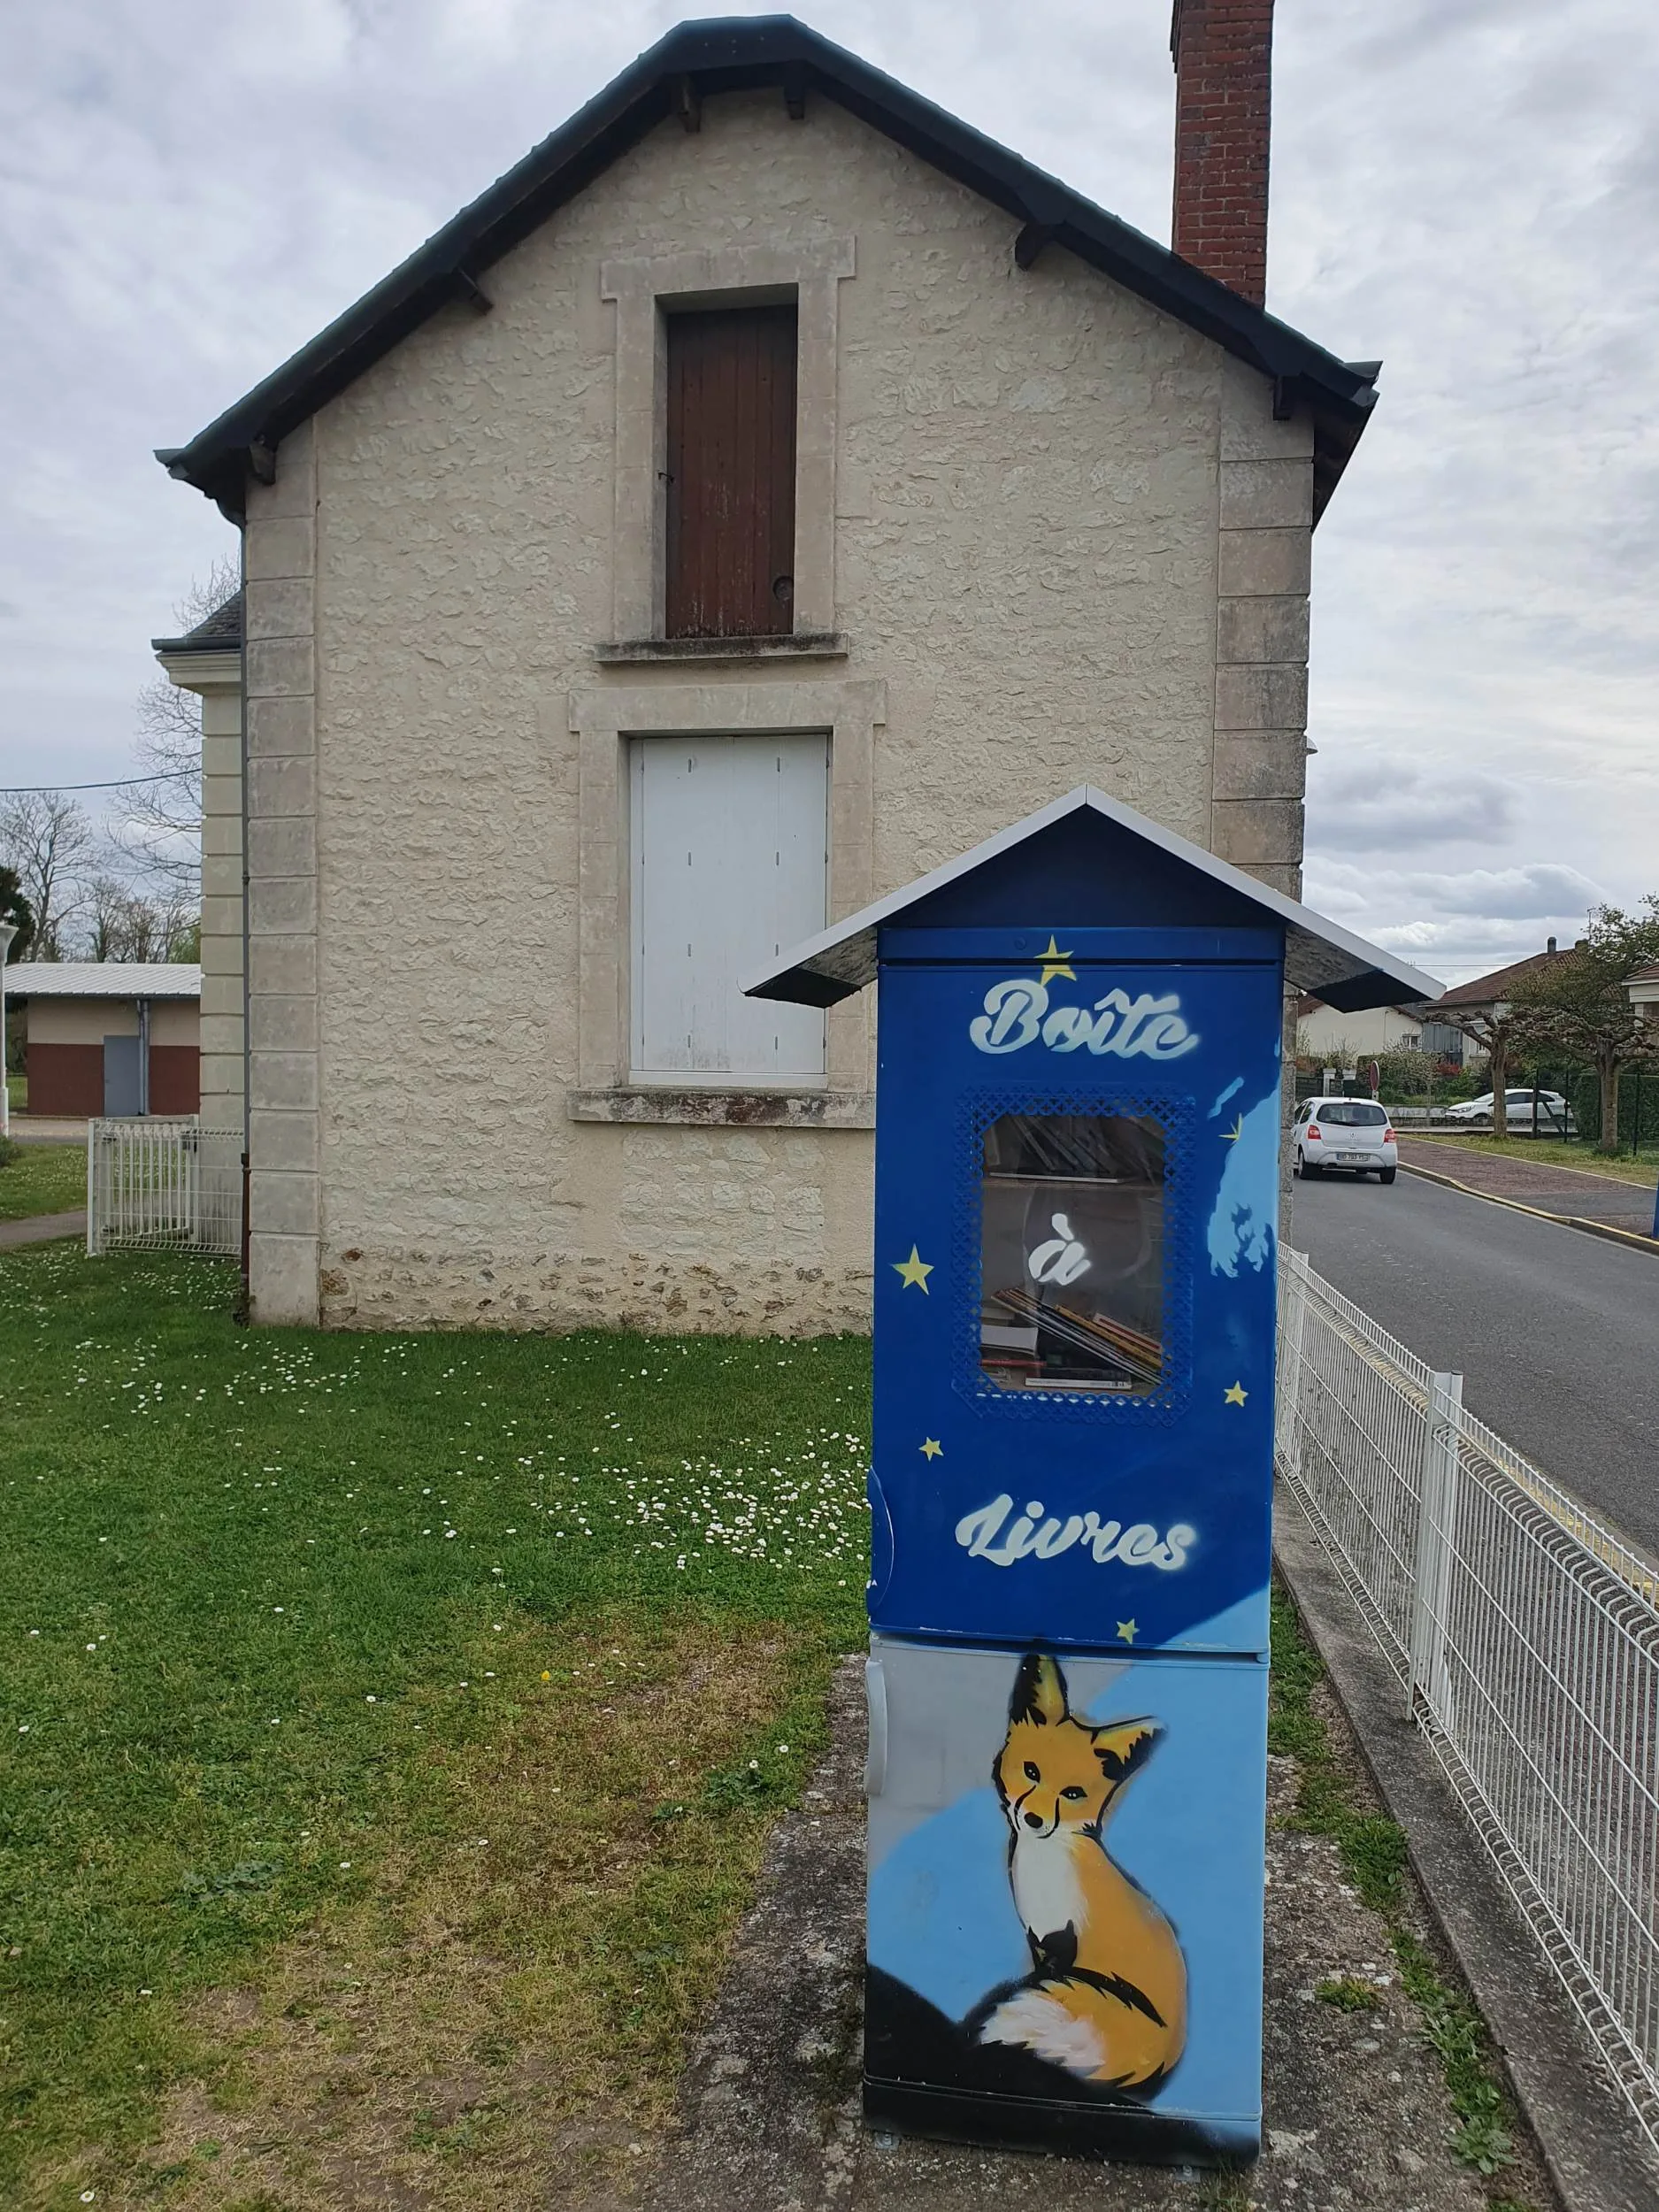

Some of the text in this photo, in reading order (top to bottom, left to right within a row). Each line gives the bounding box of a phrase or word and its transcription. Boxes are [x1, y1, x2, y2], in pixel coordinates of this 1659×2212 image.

[970, 979, 1200, 1060] Boîte
[1028, 1213, 1091, 1286] à
[955, 1494, 1196, 1571] Livres
